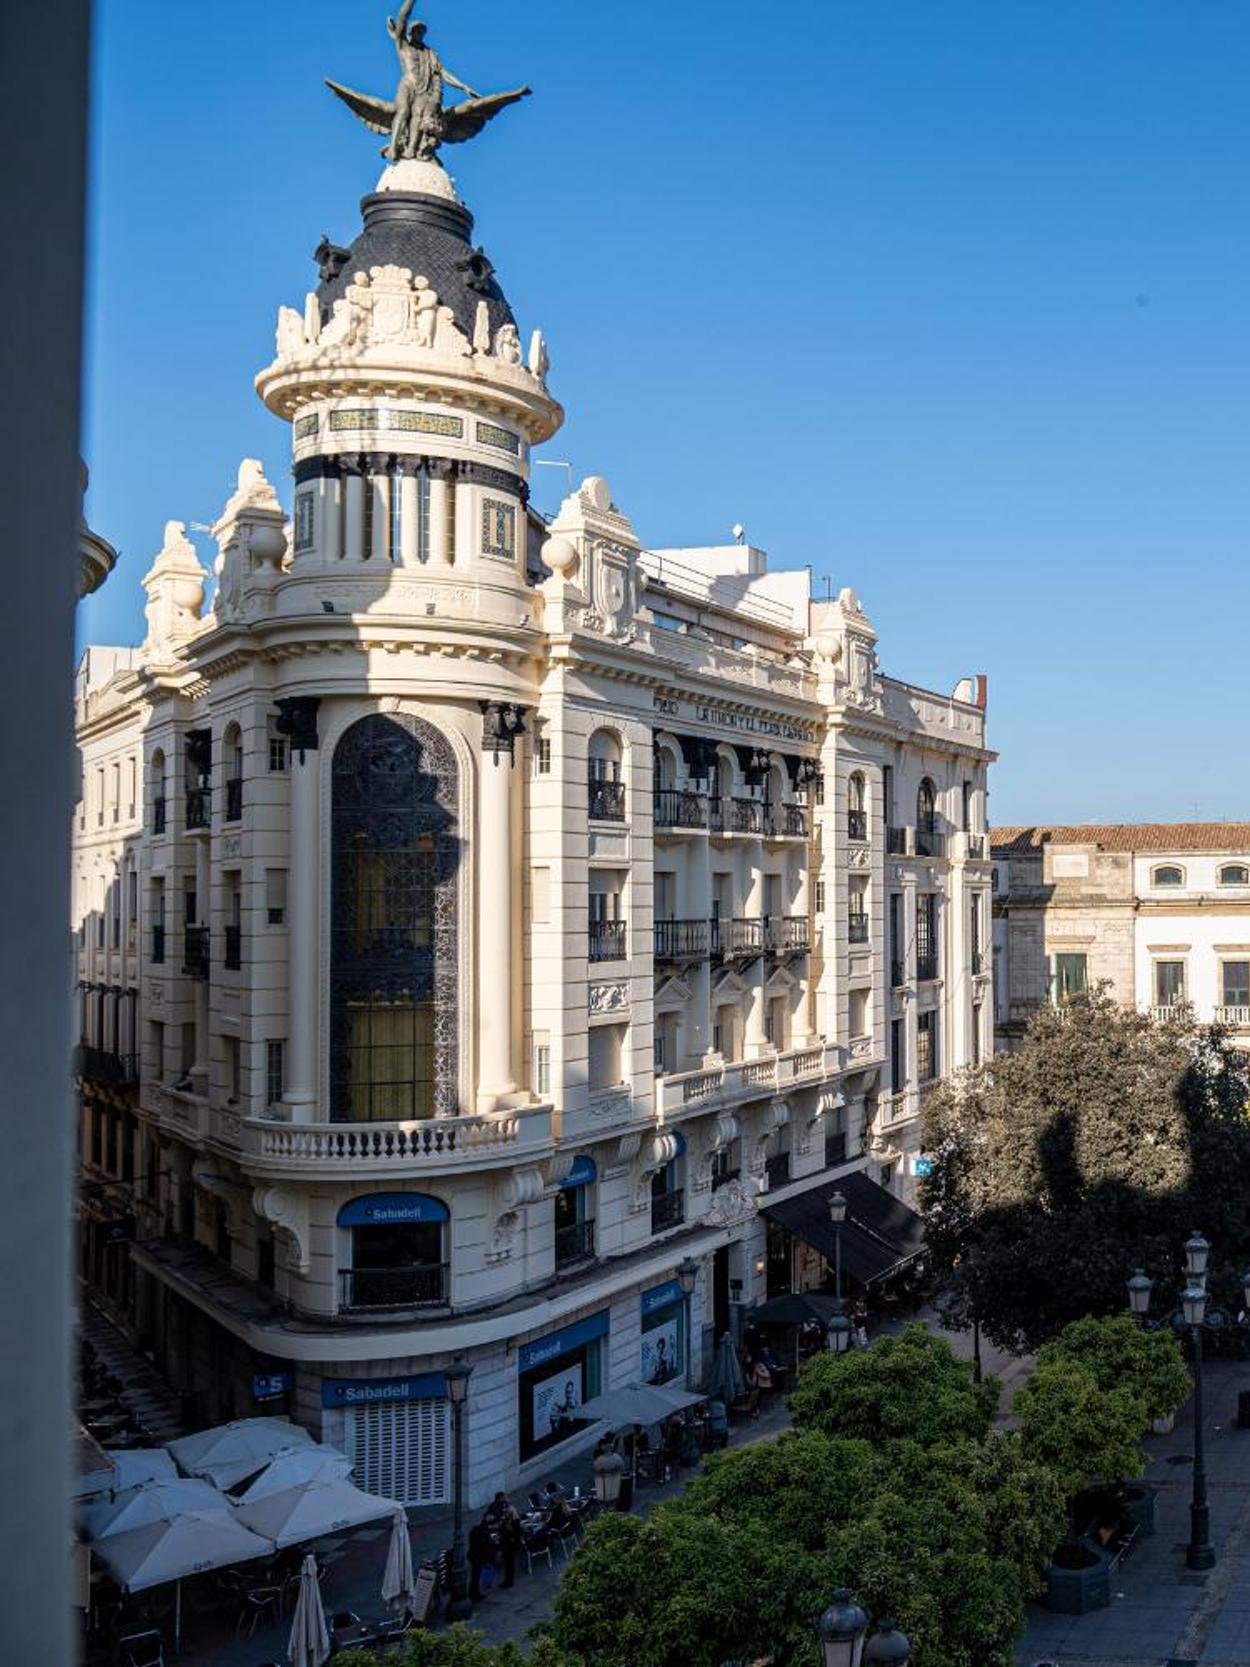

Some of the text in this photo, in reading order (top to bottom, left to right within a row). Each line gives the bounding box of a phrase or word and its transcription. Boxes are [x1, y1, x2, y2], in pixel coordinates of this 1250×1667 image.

[373, 1207, 421, 1219] Sabadell
[270, 1376, 284, 1392] S
[345, 1383, 409, 1400] Sabadell
